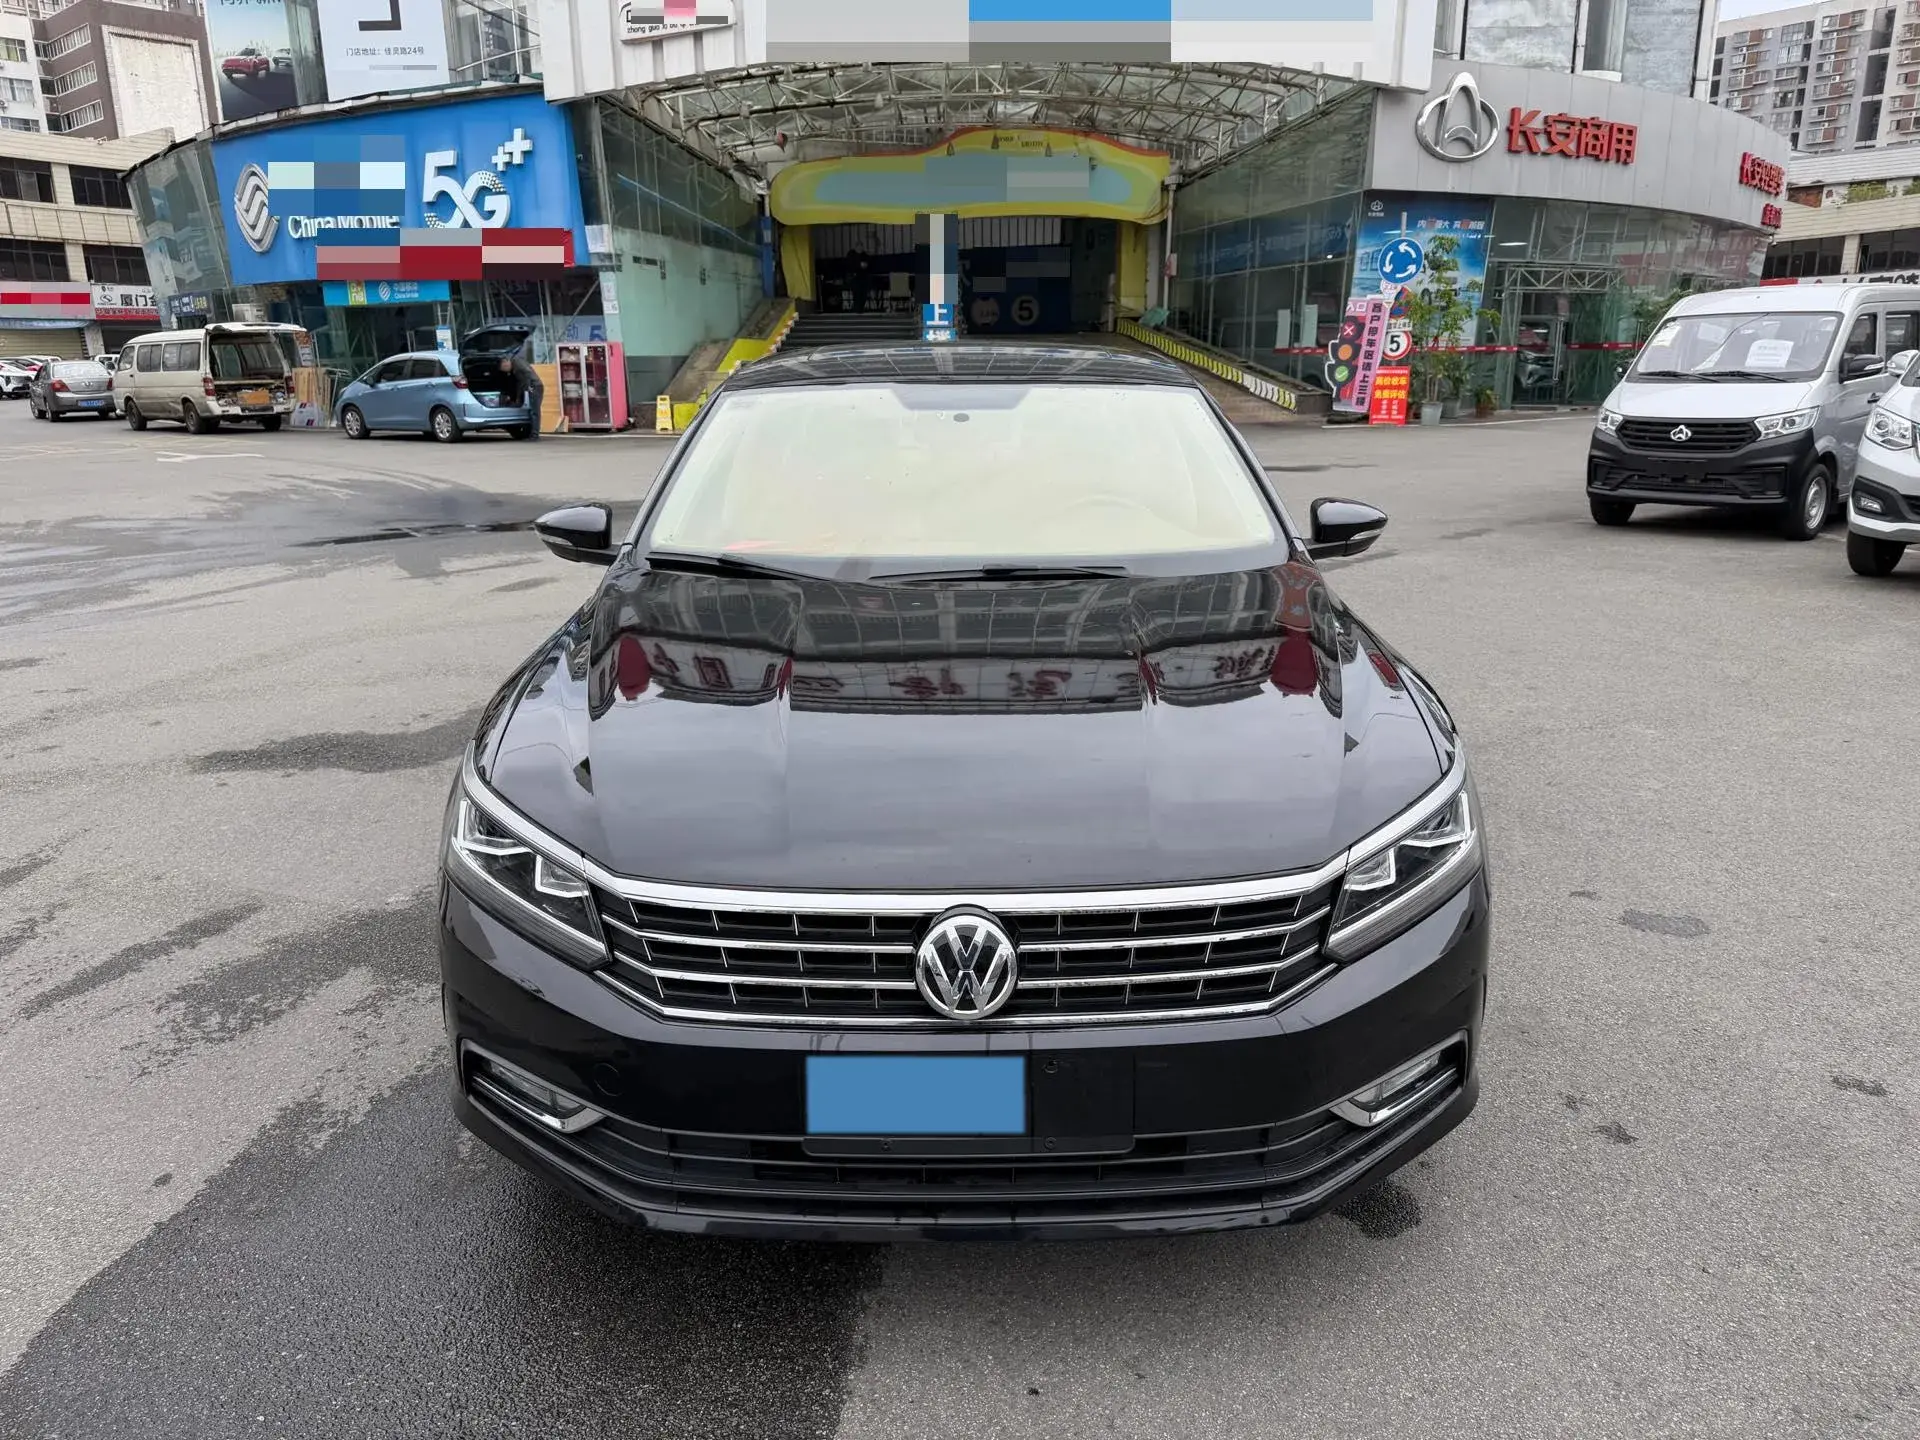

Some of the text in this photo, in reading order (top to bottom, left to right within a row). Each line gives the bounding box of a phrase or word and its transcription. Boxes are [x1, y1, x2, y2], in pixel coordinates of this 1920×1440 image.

[1507, 106, 1638, 165] 长安商用
[1388, 334, 1401, 353] 5
